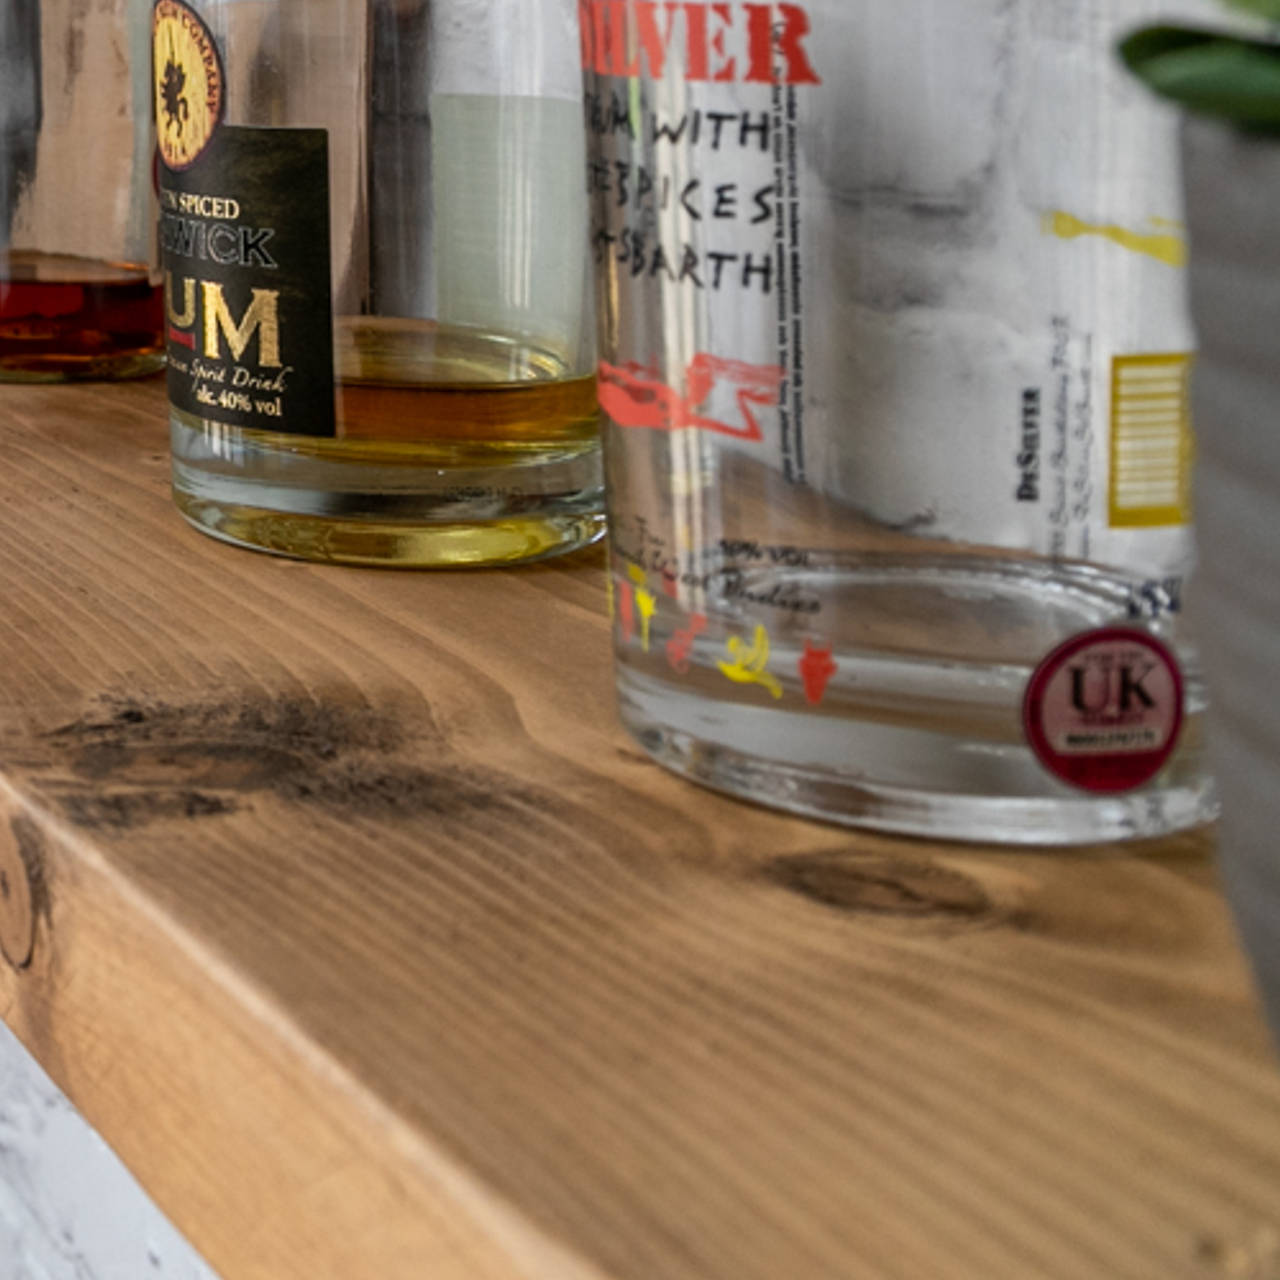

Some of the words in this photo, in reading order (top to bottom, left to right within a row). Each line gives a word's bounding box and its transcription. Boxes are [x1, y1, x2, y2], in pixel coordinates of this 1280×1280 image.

[652, 108, 771, 152] WITH
[179, 192, 240, 219] SPICED
[232, 366, 294, 392] Drink
[255, 397, 283, 417] vol
[1067, 664, 1157, 710] UK
